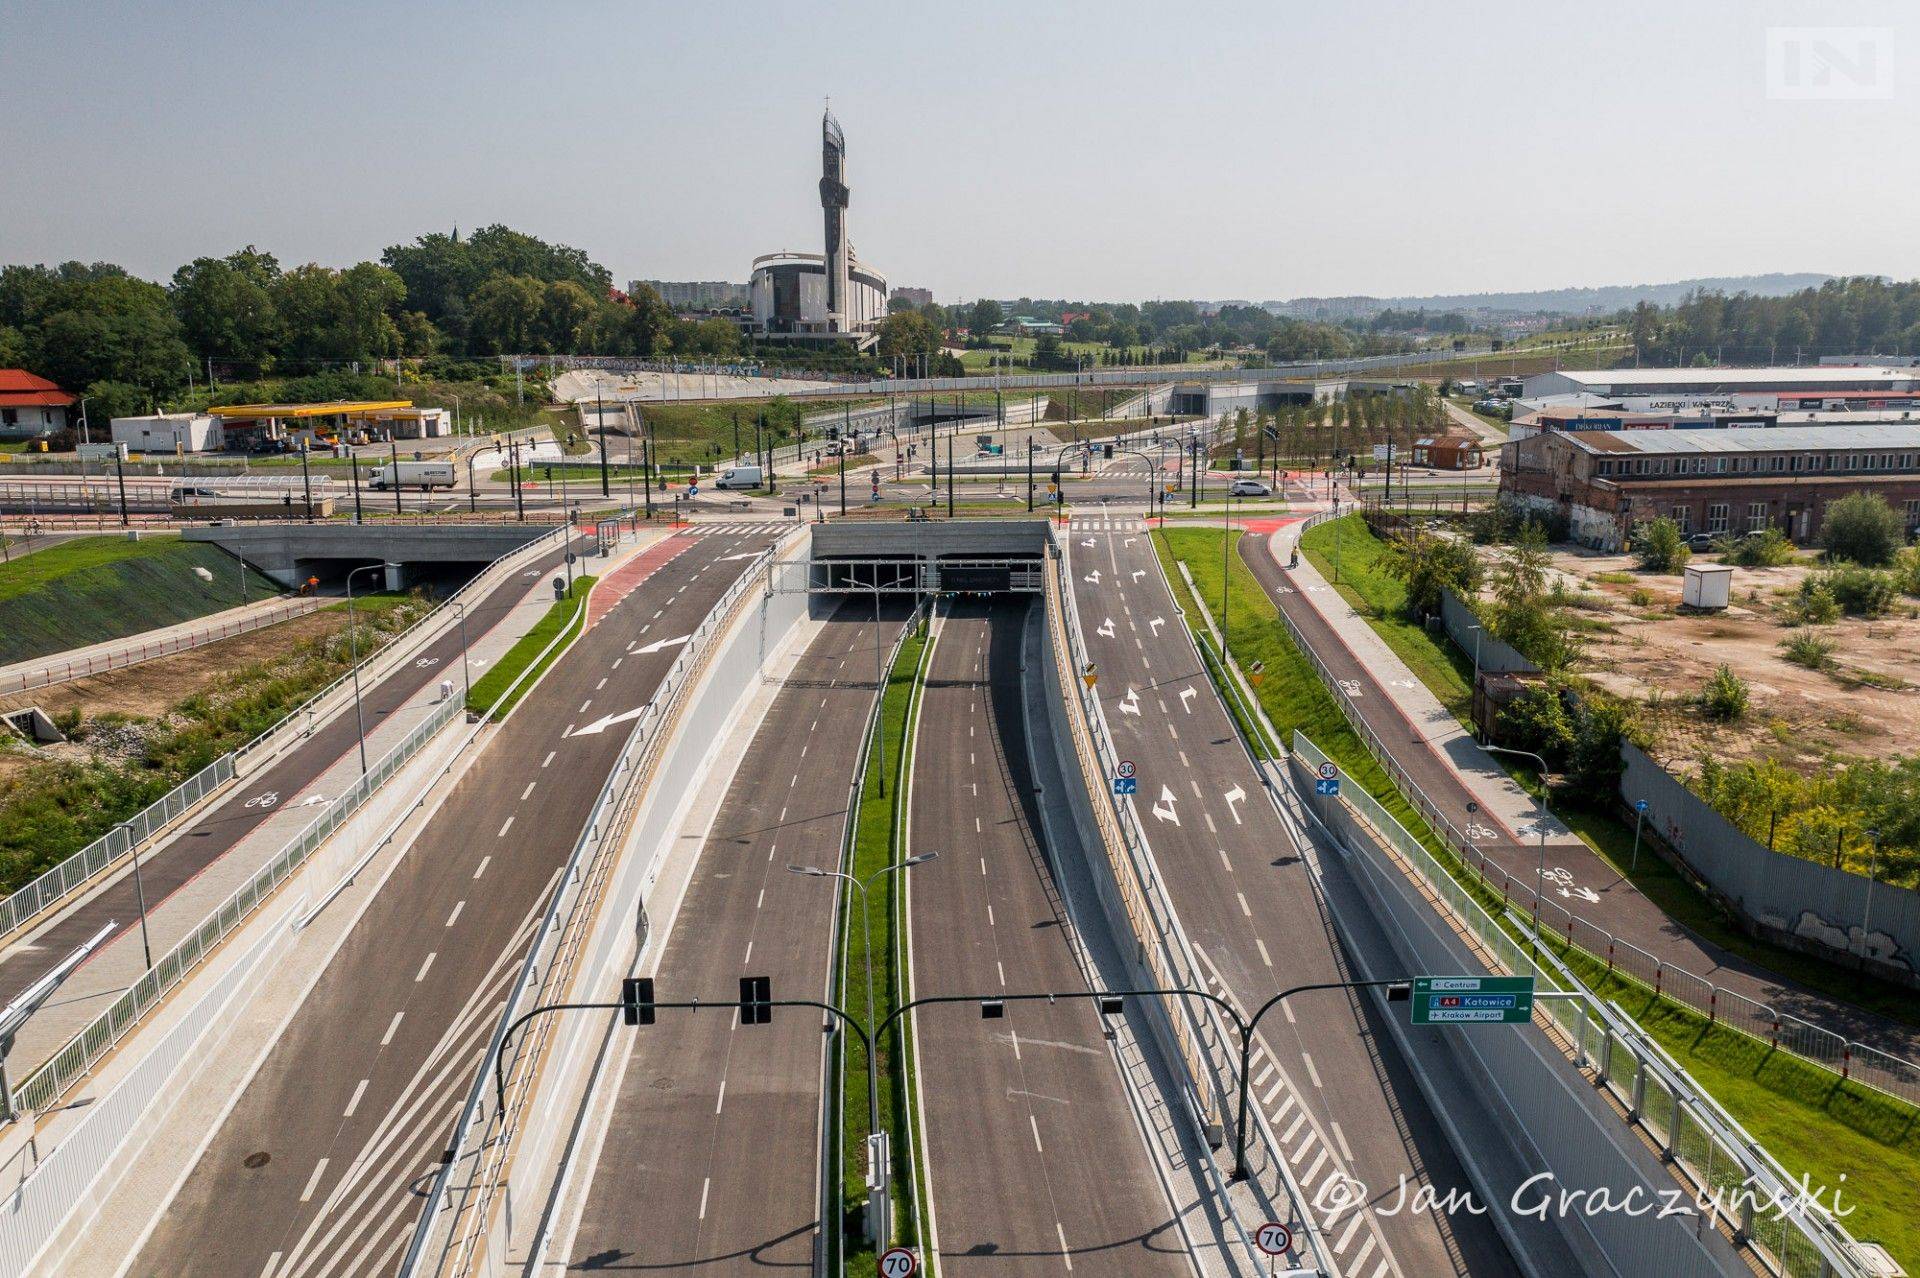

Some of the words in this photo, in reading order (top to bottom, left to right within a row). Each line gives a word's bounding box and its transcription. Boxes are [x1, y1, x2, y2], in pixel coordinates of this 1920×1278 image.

[1120, 764, 1134, 775] 30
[1321, 765, 1335, 775] 30
[1443, 981, 1478, 989] Centrum
[1444, 998, 1457, 1006] A4
[1464, 997, 1512, 1007] Katowice
[1441, 1010, 1471, 1018] Kraków
[1473, 1010, 1502, 1020] Airport
[1263, 1231, 1287, 1247] 70
[886, 1257, 910, 1274] 70
